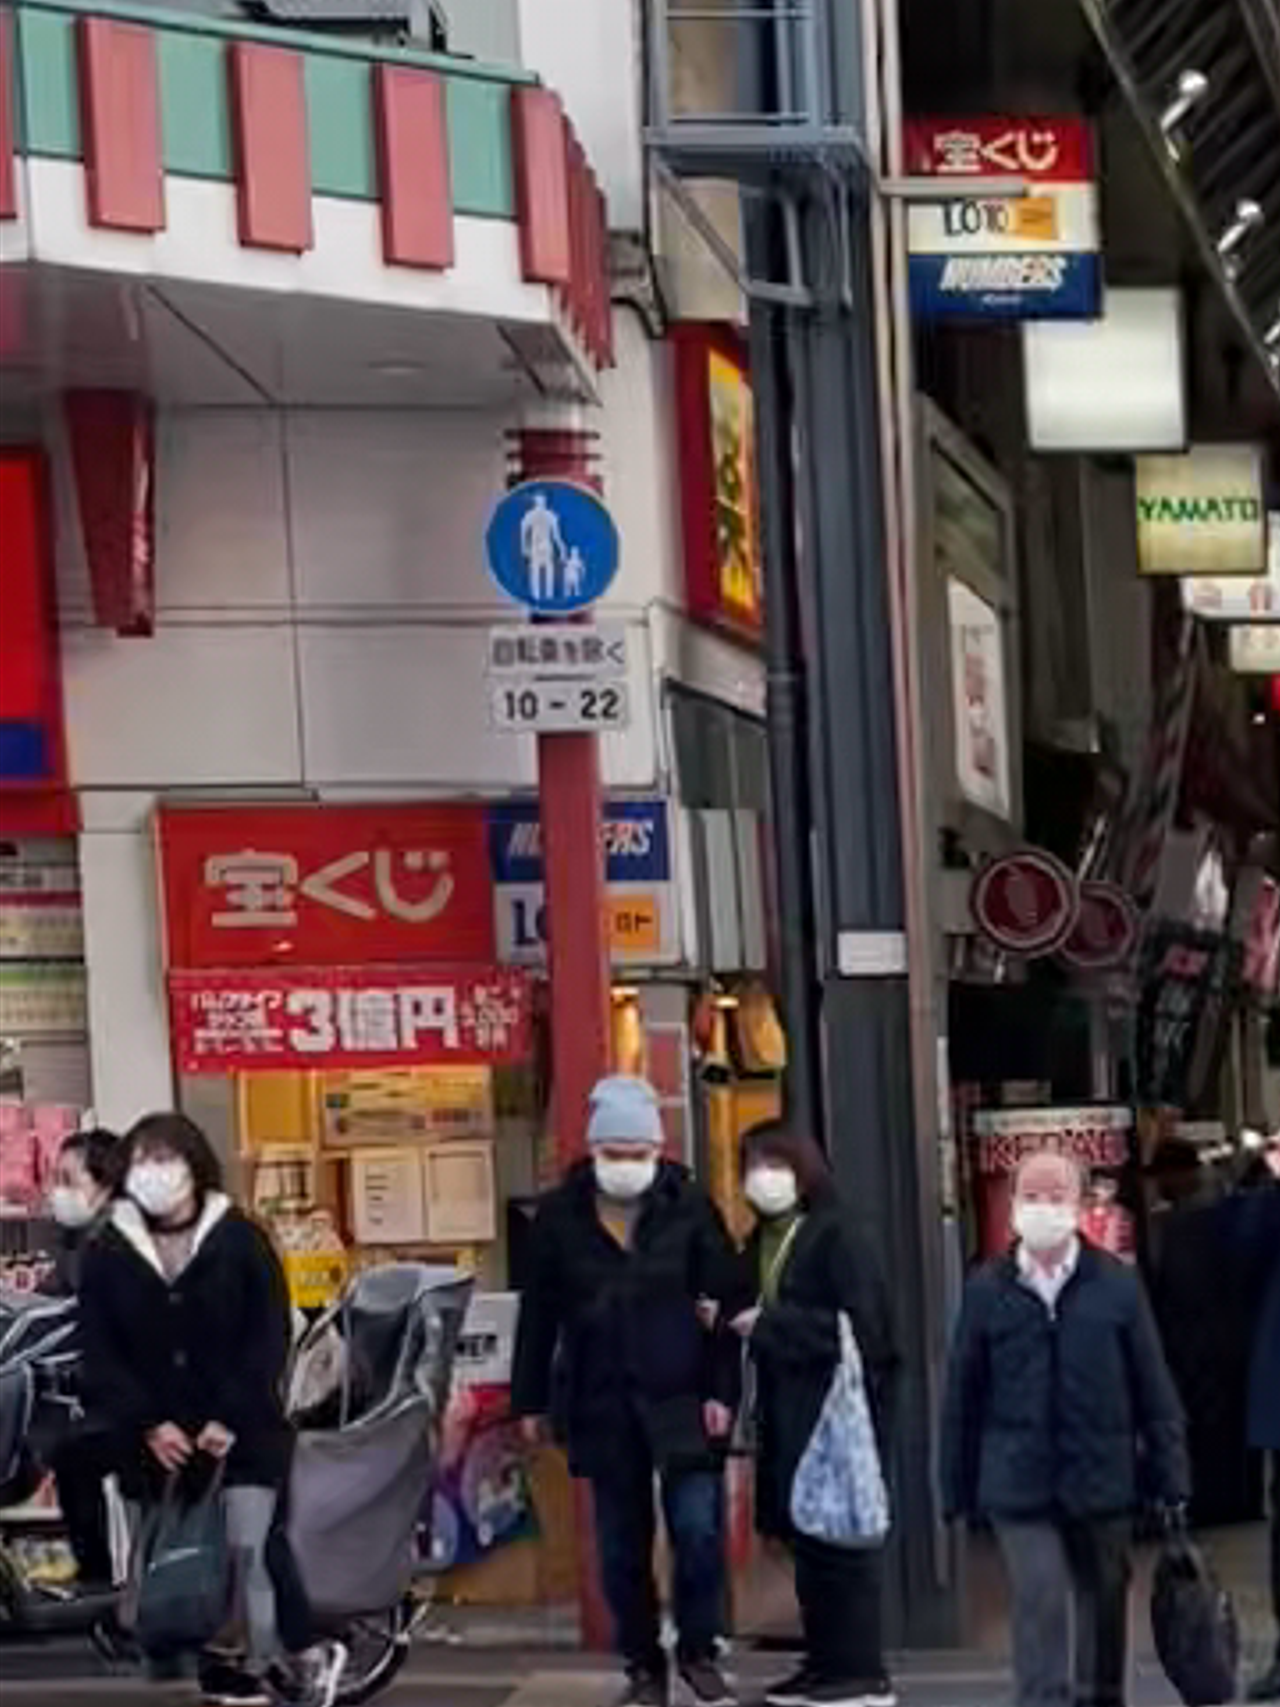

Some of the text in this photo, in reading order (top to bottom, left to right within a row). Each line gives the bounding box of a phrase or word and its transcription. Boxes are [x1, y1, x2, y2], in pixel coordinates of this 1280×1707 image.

[933, 129, 1059, 173] 宝くじ
[1136, 498, 1259, 524] YAMATO
[204, 847, 454, 929] 宝くじ
